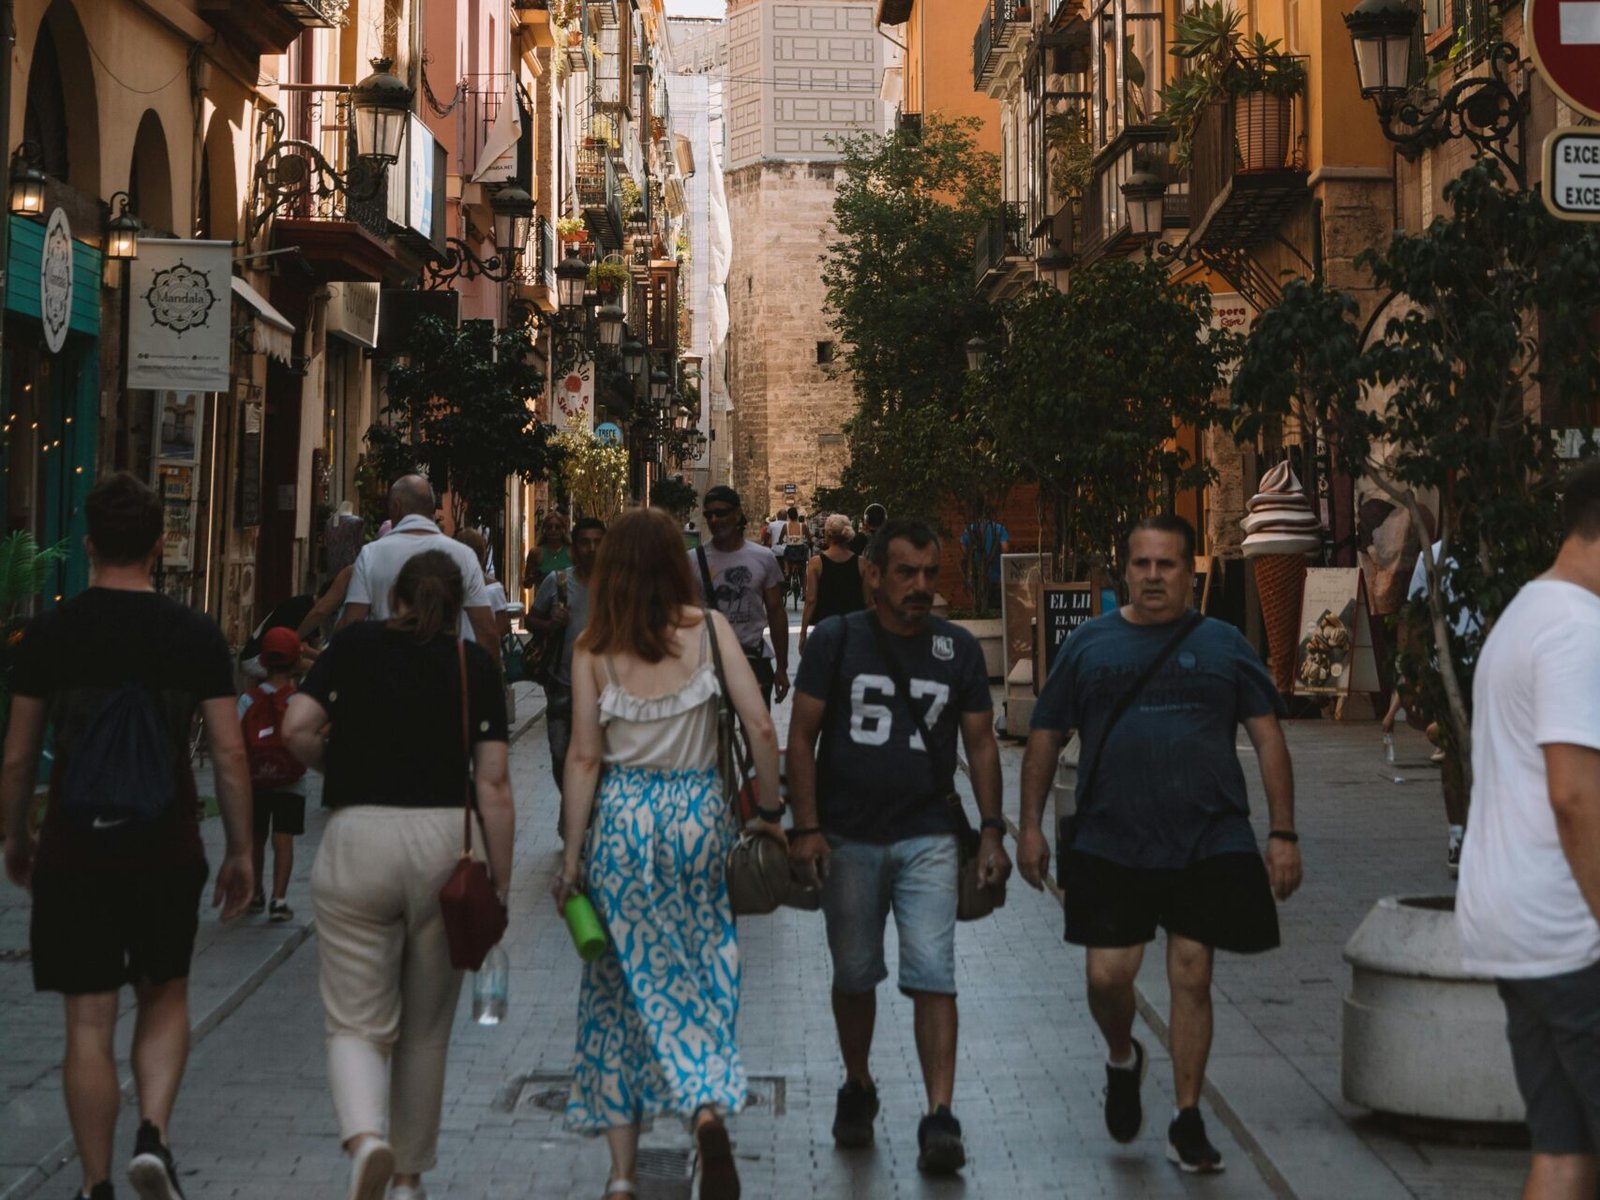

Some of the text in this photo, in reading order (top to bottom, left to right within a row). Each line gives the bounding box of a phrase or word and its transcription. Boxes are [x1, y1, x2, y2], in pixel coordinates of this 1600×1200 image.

[1564, 145, 1600, 164] EXCE
[1565, 187, 1600, 205] EXCE
[1050, 593, 1068, 609] EL
[1055, 615, 1068, 625] EL
[850, 673, 950, 752] 67
